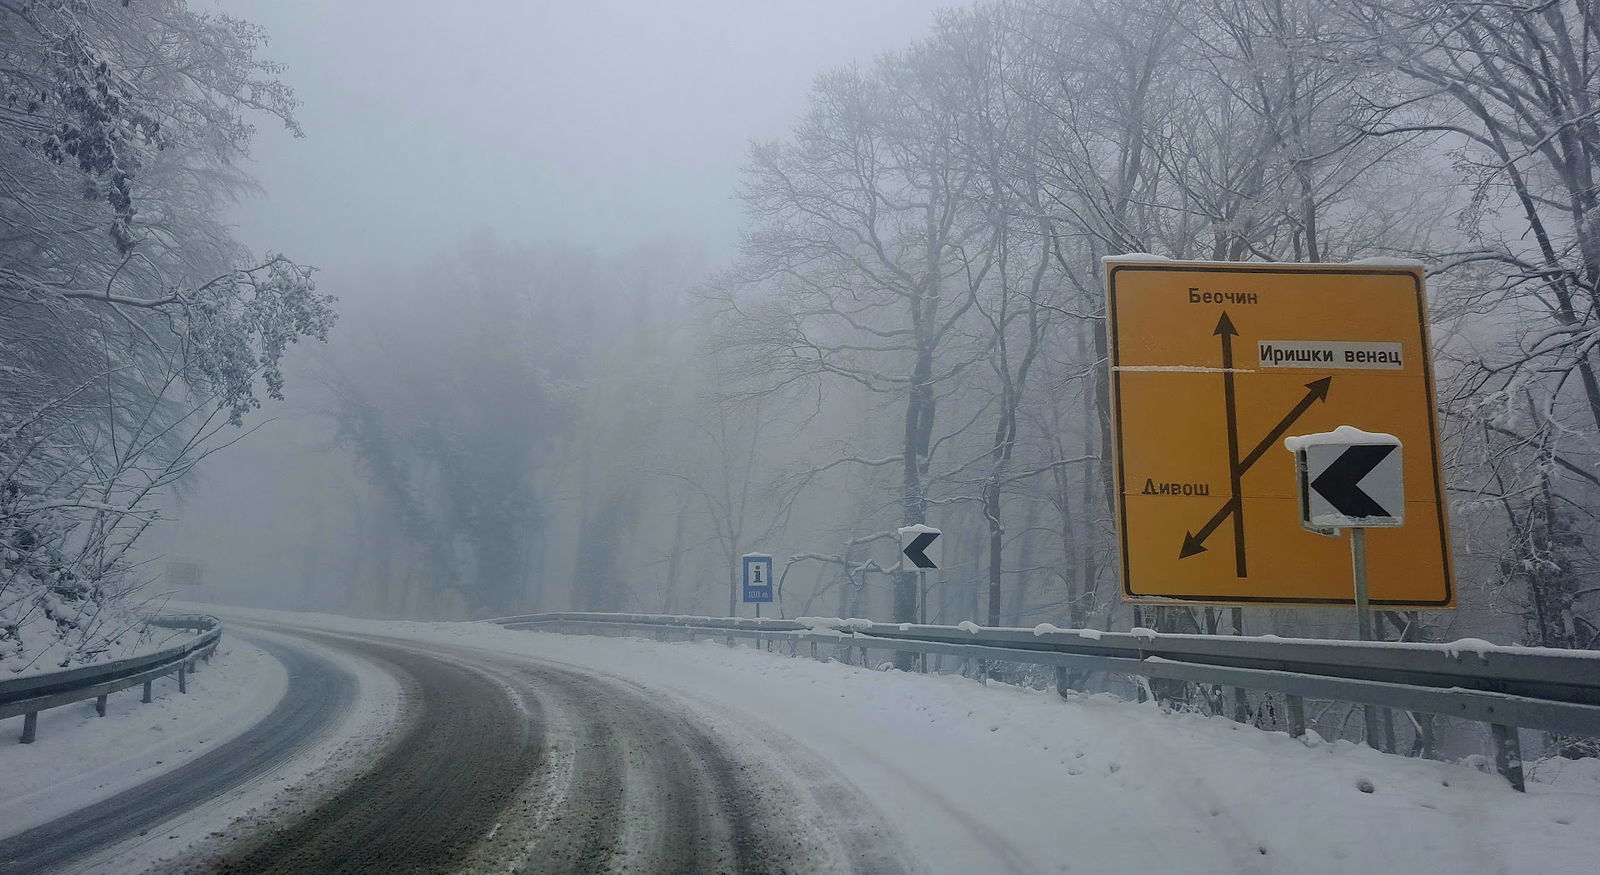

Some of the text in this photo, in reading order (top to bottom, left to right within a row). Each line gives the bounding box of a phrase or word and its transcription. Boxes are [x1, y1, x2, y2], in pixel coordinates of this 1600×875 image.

[1189, 288, 1258, 304] Беочин
[1260, 345, 1402, 366] Иришки венац
[1142, 478, 1209, 496] Дивош
